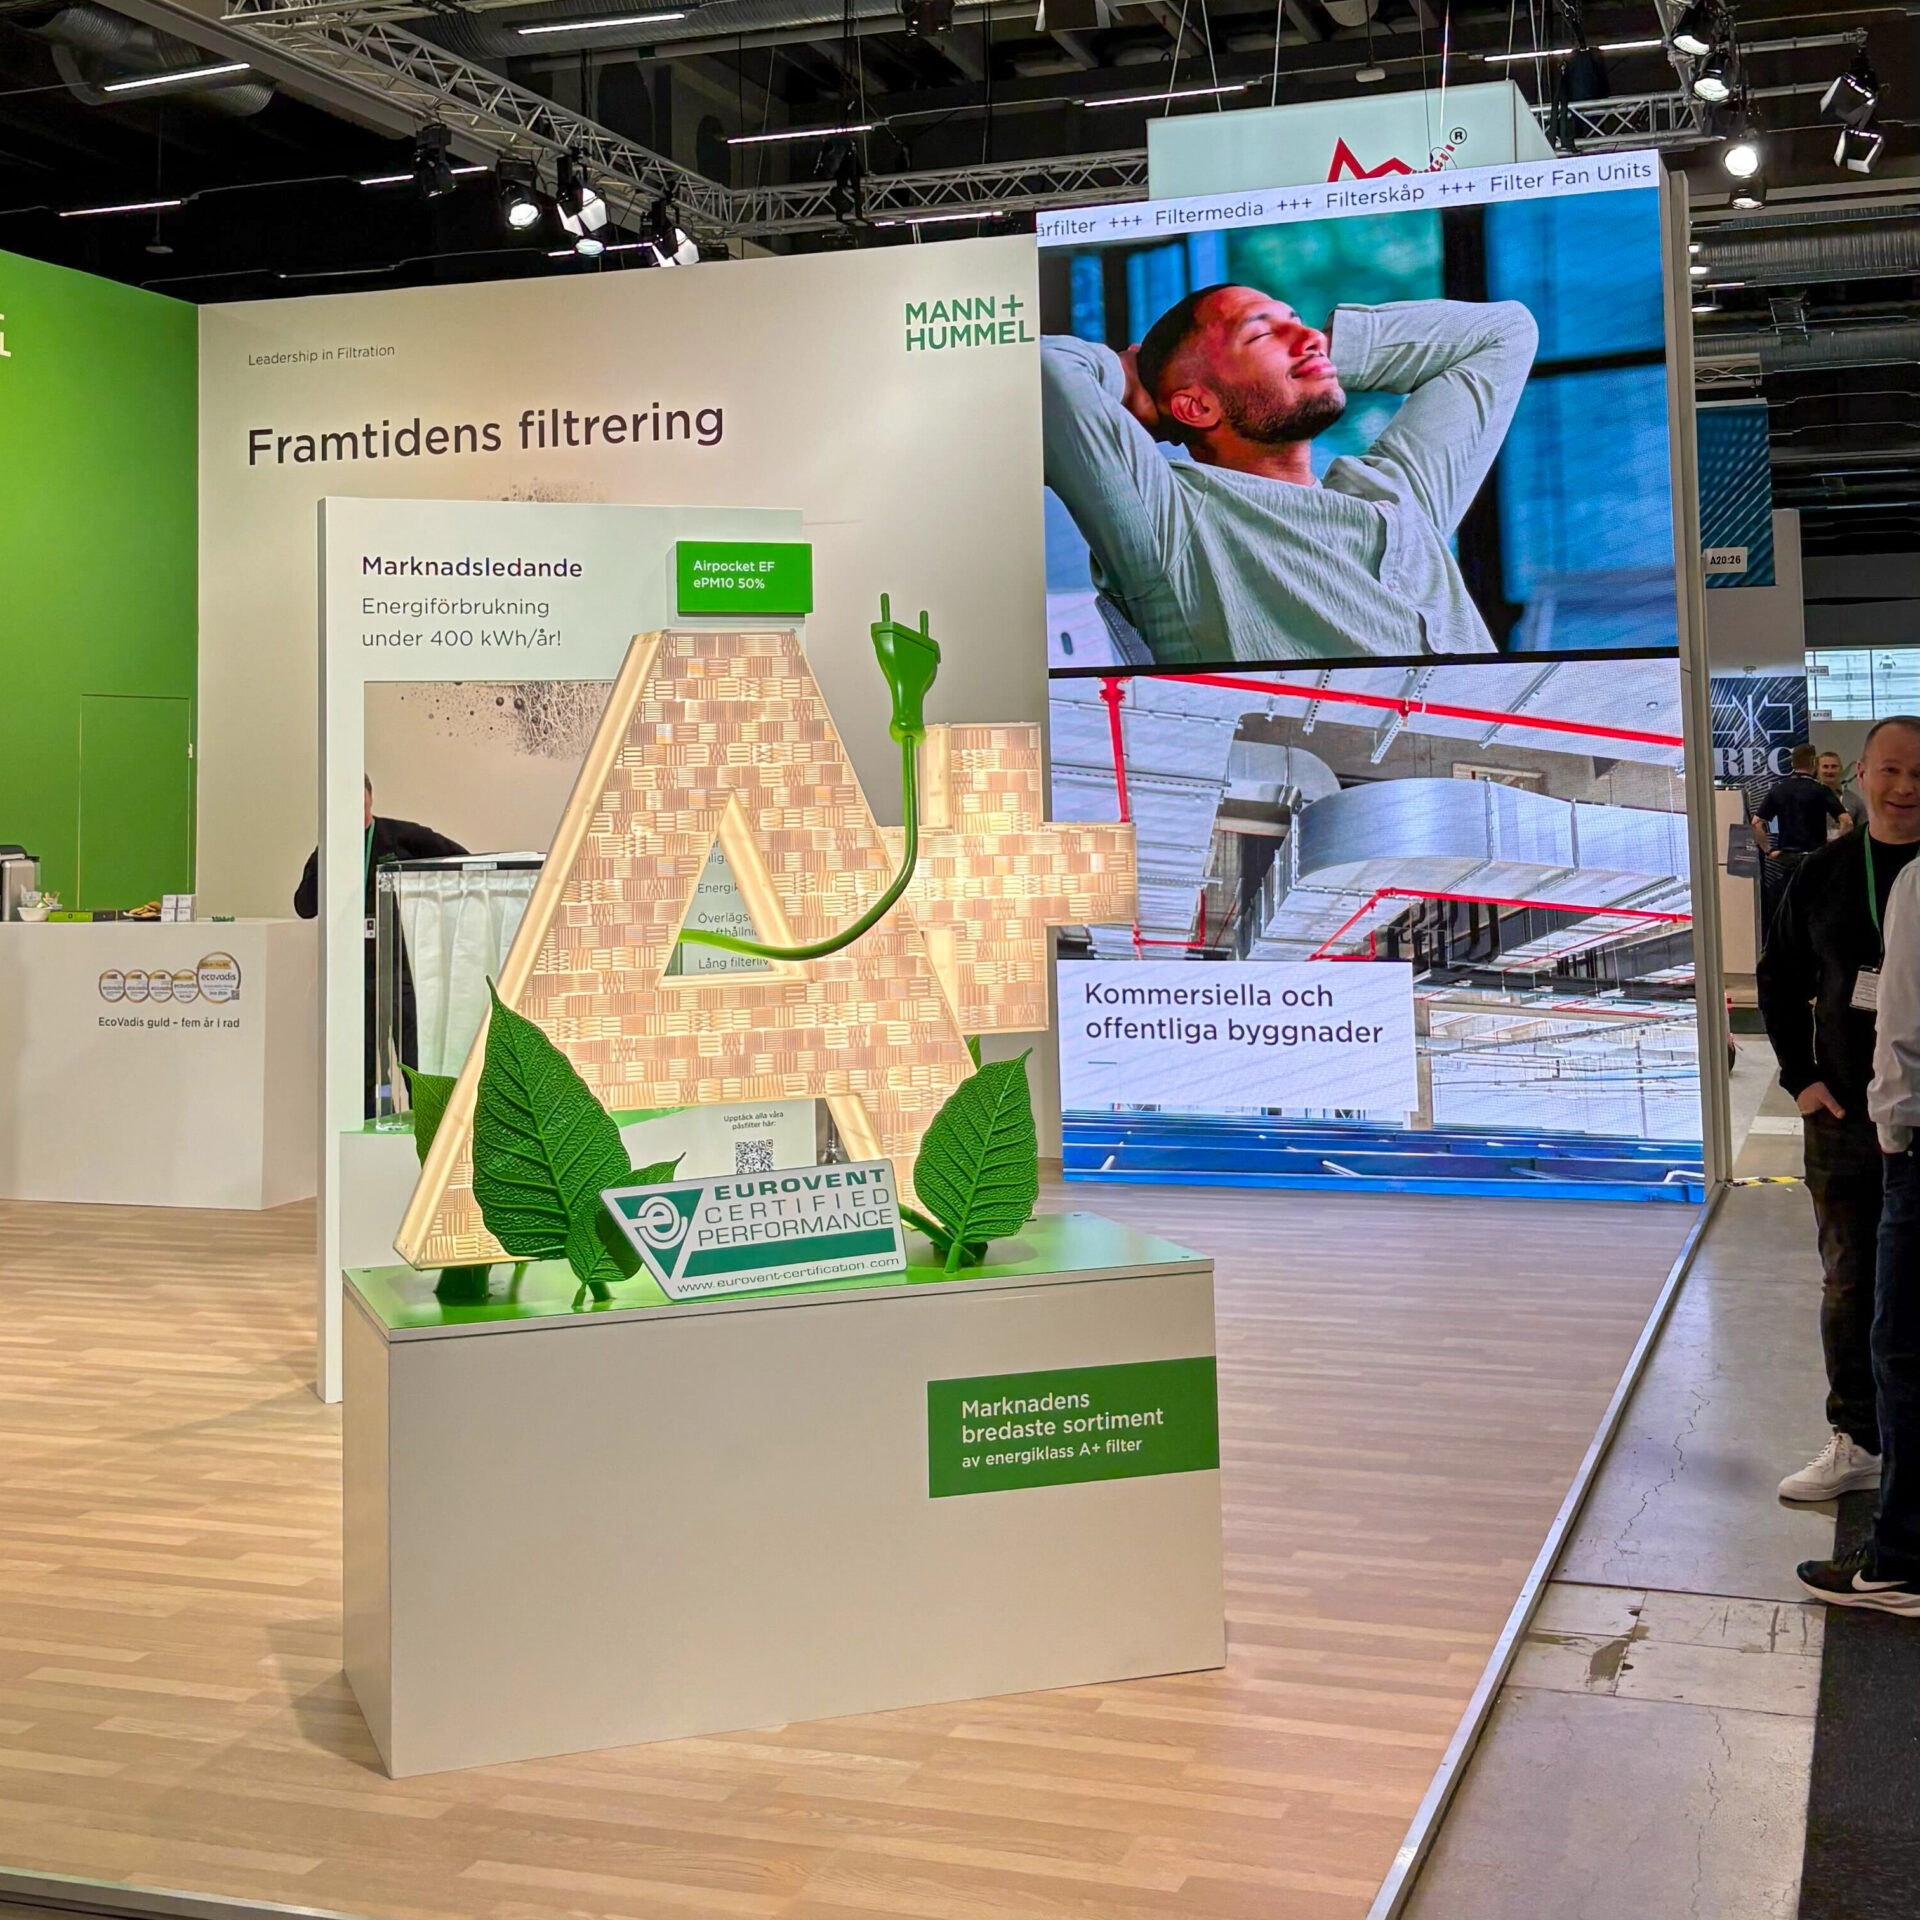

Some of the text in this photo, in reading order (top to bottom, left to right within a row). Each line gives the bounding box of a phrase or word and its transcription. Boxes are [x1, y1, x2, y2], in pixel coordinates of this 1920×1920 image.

[1155, 202, 1264, 225] Filtermedia
[1327, 183, 1424, 208] Filterskåp
[1490, 173, 1543, 192] Filter
[1552, 169, 1589, 186] Fan
[1598, 162, 1652, 181] Units
[906, 320, 1035, 351] HUMMEL
[248, 345, 395, 366] Leadership in Filtration
[249, 402, 723, 465] Framtidens filtrering
[362, 556, 583, 577] Marknadsledande
[693, 560, 775, 573] Airpocket EF
[1710, 555, 1741, 565] A20:26
[693, 577, 765, 589] ePM10 50%
[362, 598, 549, 617] Energiförbrukning
[362, 628, 561, 648] under 400 kWh/år!
[698, 957, 727, 970] Lång
[201, 972, 236, 981] ecovadis
[1085, 983, 1333, 1007] Kommersiella och
[98, 1016, 144, 1027] EcoVadis
[147, 1017, 170, 1029] guld
[181, 1017, 201, 1027] fem
[204, 1017, 214, 1028] år
[223, 1018, 240, 1028] rad
[1086, 1017, 1383, 1046] offentliga byggnader
[723, 1113, 753, 1122] Upptäck
[769, 1110, 784, 1118] våra
[732, 1121, 761, 1130] påsfilter
[715, 1168, 885, 1200] EUROVENT
[705, 1188, 889, 1224] CERTIFIED
[698, 1208, 893, 1247] PERFORMANCE
[961, 1392, 1090, 1419] Marknadens
[961, 1407, 1164, 1443] bredaste sortiment
[961, 1438, 1142, 1468] av energiklass A+ filter
